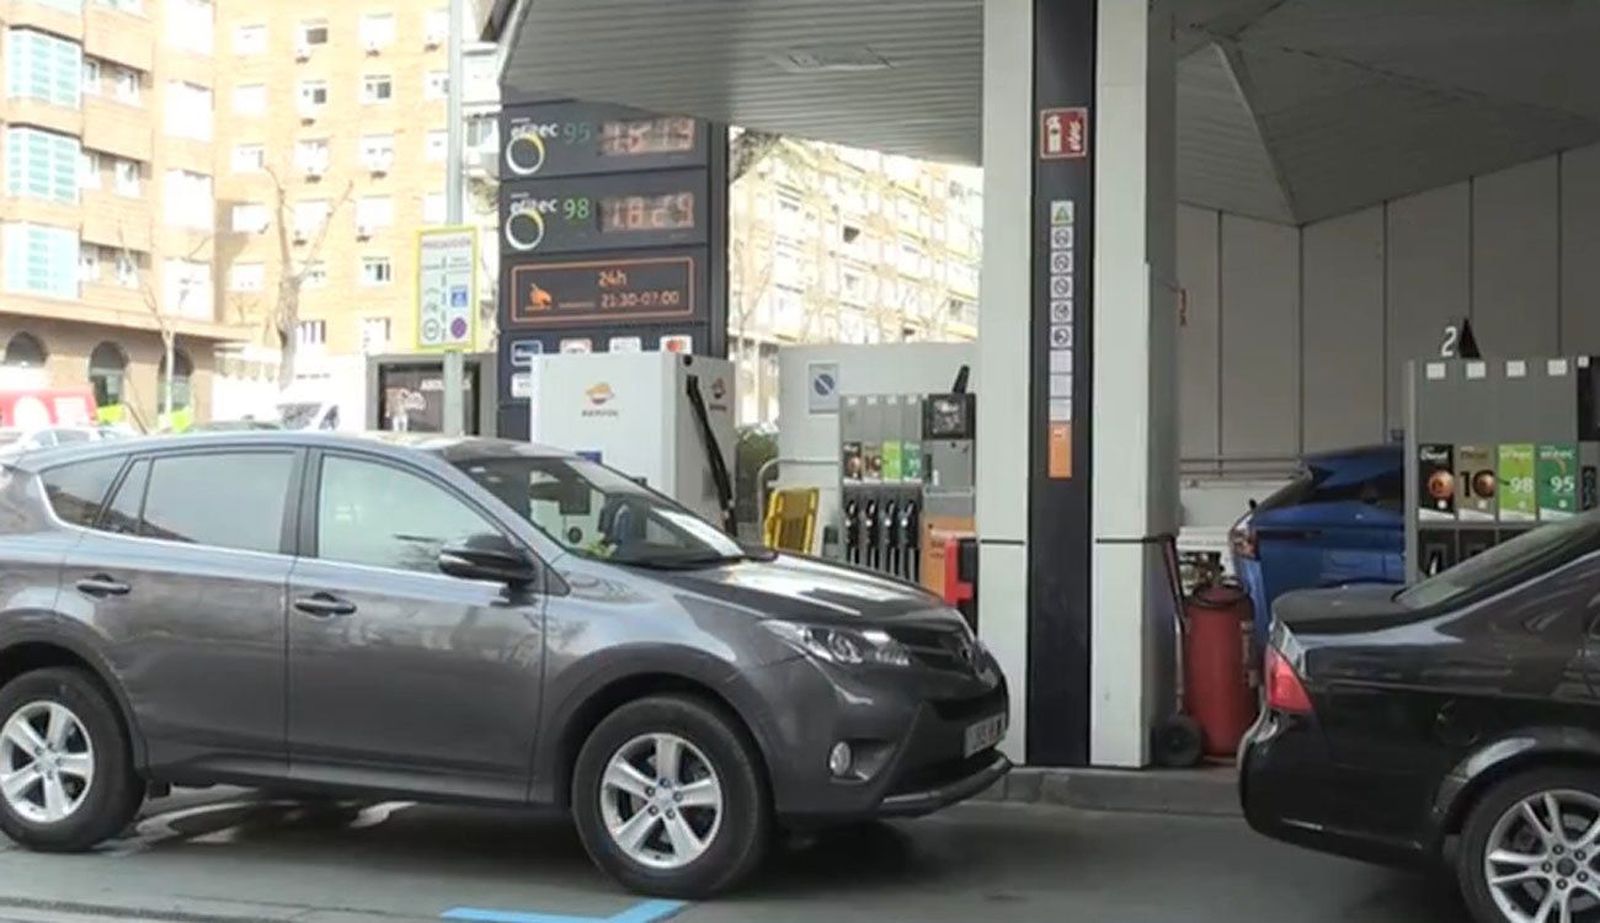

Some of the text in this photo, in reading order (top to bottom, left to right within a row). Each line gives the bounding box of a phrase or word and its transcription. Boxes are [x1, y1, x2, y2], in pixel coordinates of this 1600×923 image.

[564, 122, 591, 144] 95
[564, 198, 590, 219] 98
[1441, 326, 1457, 357] 2
[1509, 476, 1534, 494] 98
[1550, 476, 1575, 494] 95
